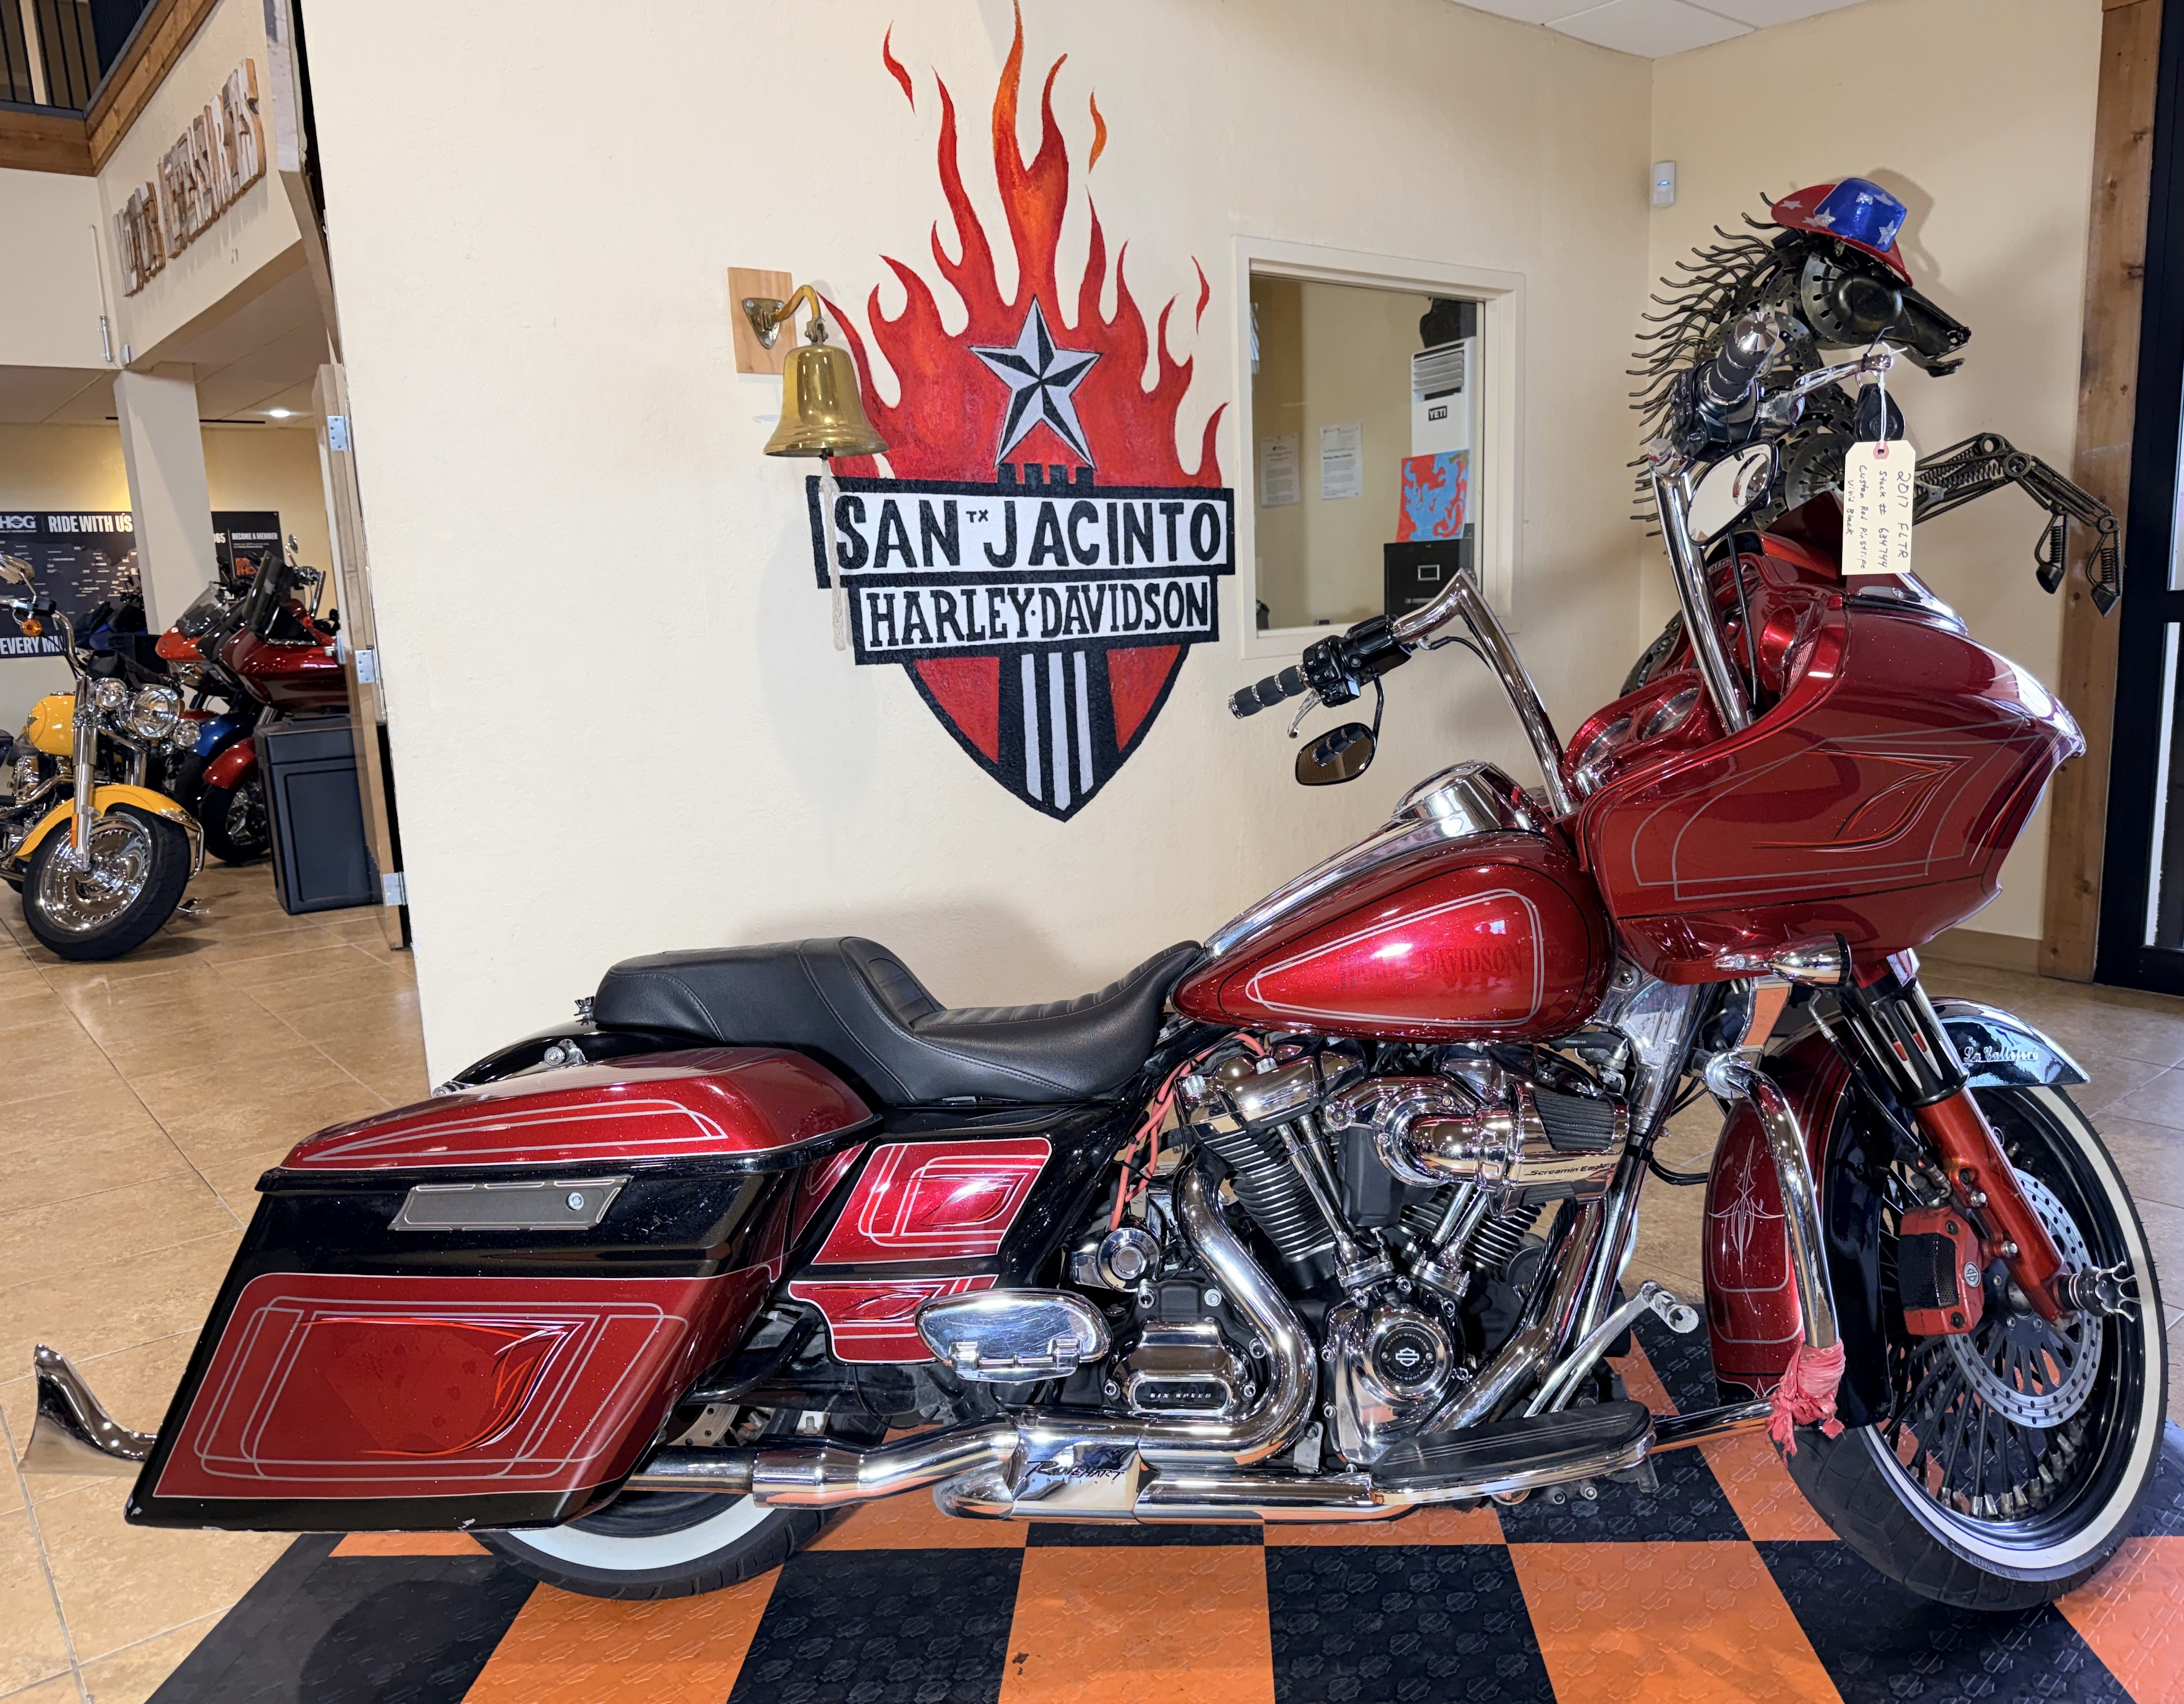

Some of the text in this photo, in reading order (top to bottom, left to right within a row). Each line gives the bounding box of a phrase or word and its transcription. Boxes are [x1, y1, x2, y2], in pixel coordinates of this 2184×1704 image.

[1429, 408, 1446, 419] YETI
[1859, 465, 1868, 498] Custom
[1897, 471, 1911, 508] 2017
[1879, 503, 1886, 516] #
[47, 516, 79, 532] RIDE
[79, 515, 113, 532] WITH
[115, 514, 133, 532] US
[836, 496, 1221, 569] SAN TX JACINTO
[1845, 509, 1854, 536] Black
[214, 532, 225, 543] 65
[1878, 528, 1889, 567] 634744
[0, 636, 39, 654] EVERY
